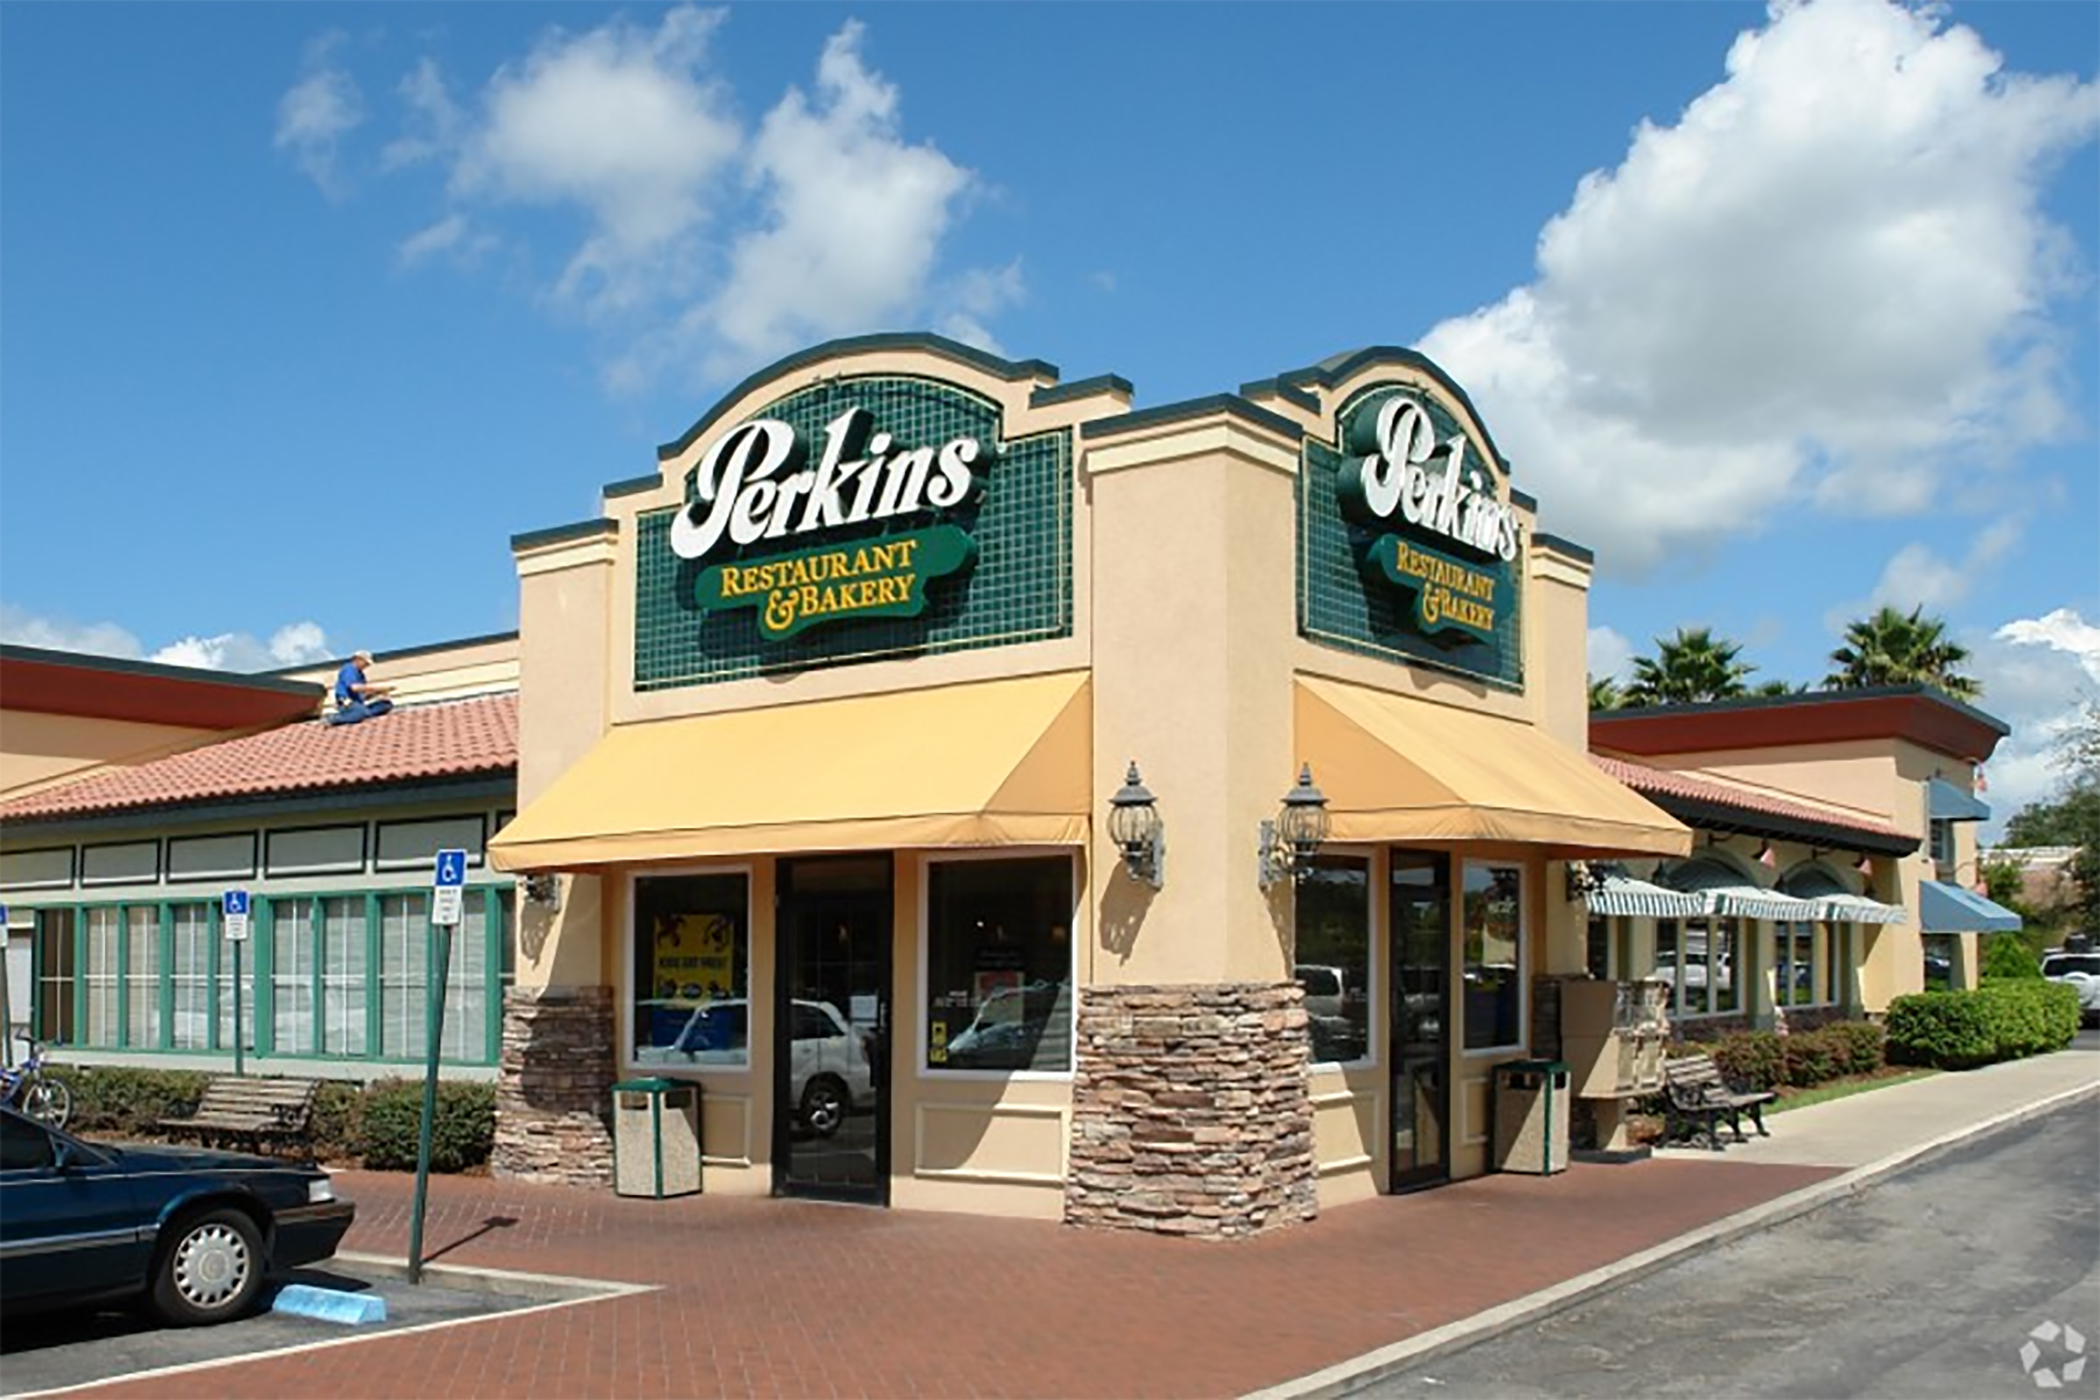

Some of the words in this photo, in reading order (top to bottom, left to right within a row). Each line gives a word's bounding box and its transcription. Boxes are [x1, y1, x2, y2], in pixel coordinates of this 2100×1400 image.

[670, 406, 980, 559] Perkins
[1360, 396, 1519, 562] Perkins
[720, 539, 917, 598] RESTAURANT
